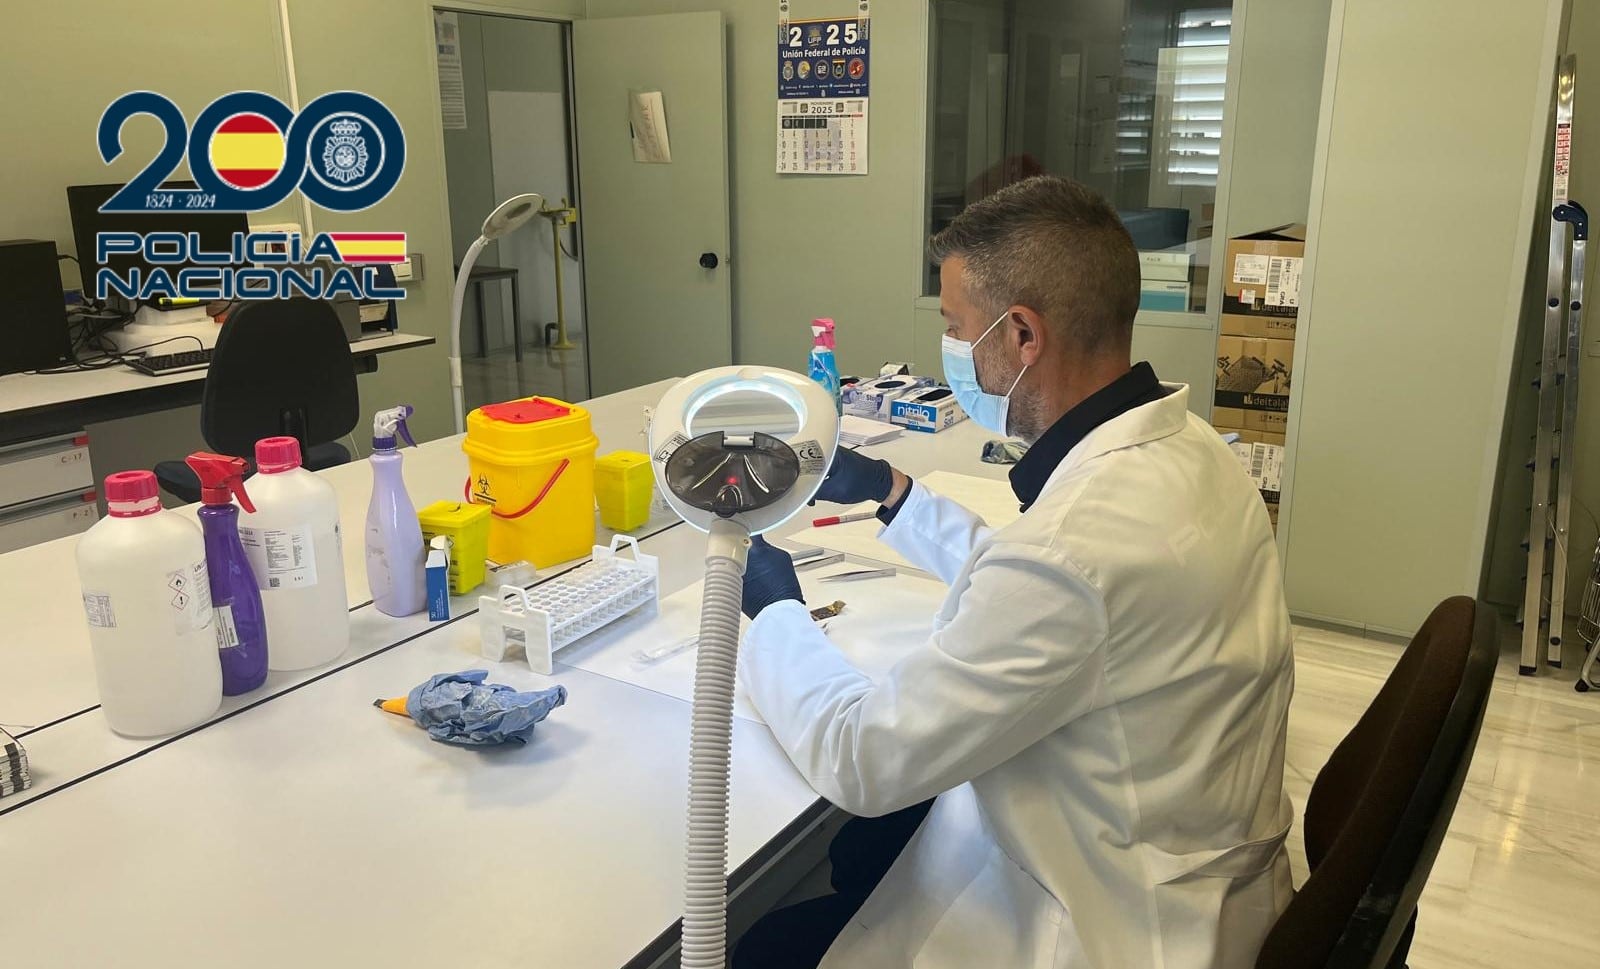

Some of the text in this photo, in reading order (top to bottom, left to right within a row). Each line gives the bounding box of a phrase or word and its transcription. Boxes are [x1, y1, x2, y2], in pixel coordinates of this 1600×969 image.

[782, 46, 866, 59] Unión Federal de Policía
[811, 106, 833, 114] 2025
[897, 404, 930, 418] nitrilo
